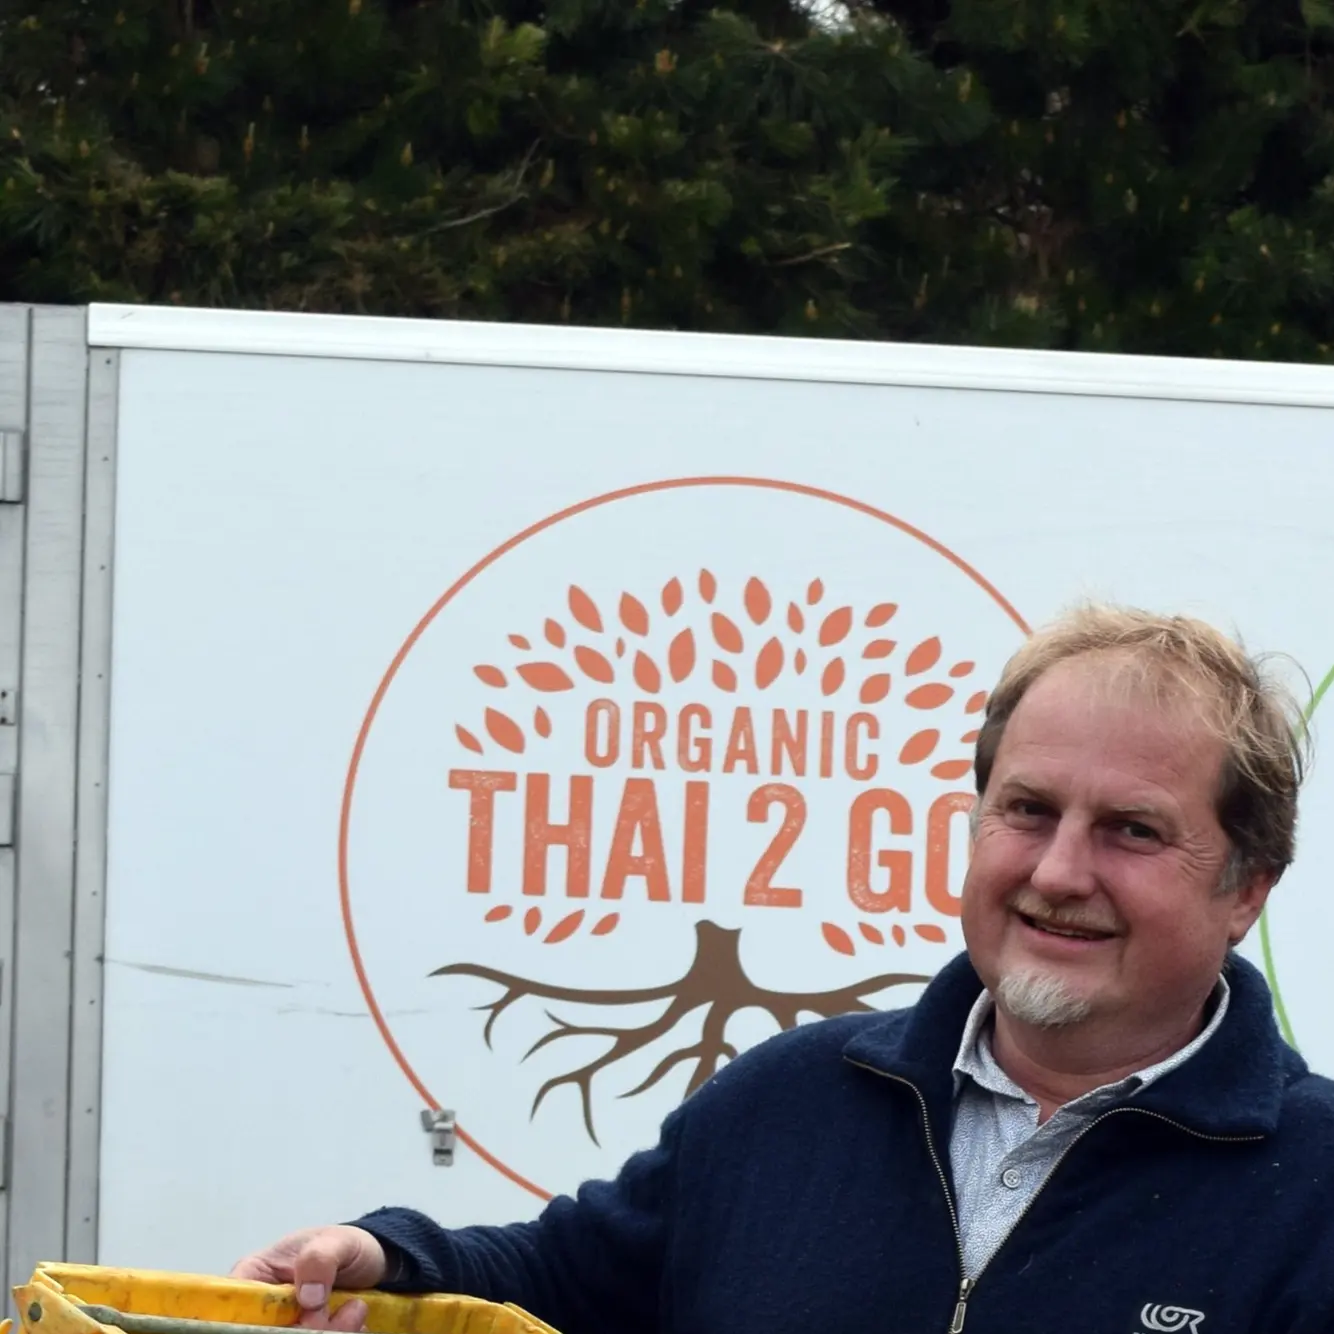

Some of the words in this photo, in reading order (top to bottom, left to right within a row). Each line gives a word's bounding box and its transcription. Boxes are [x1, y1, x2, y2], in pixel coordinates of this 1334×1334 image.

[584, 698, 880, 782] ORGANIC
[447, 768, 710, 905] THAI
[742, 782, 808, 908] 2
